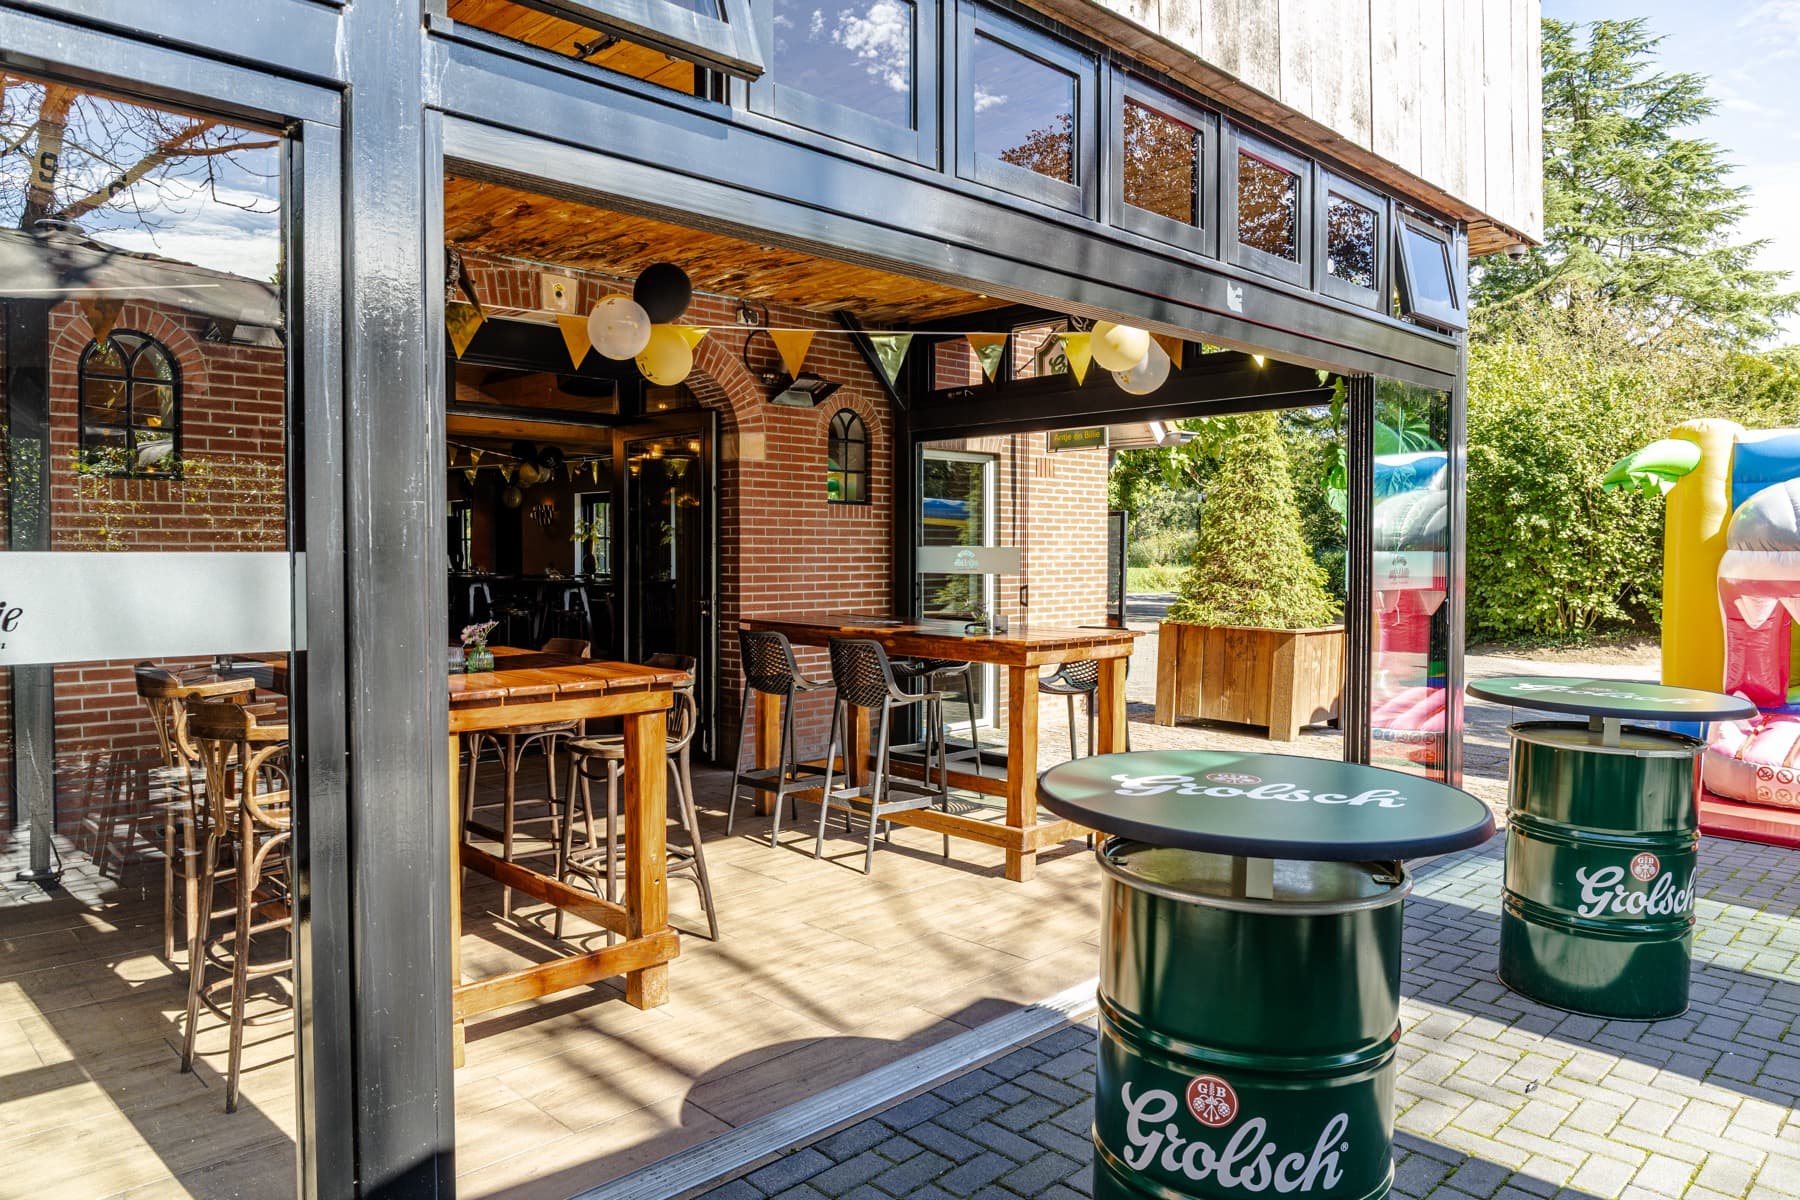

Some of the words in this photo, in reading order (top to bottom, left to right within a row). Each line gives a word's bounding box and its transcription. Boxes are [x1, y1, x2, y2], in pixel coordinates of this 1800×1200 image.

[1110, 773, 1407, 808] Grolsch
[1575, 865, 1697, 918] Grolsch
[1121, 1081, 1349, 1193] Grolsch
